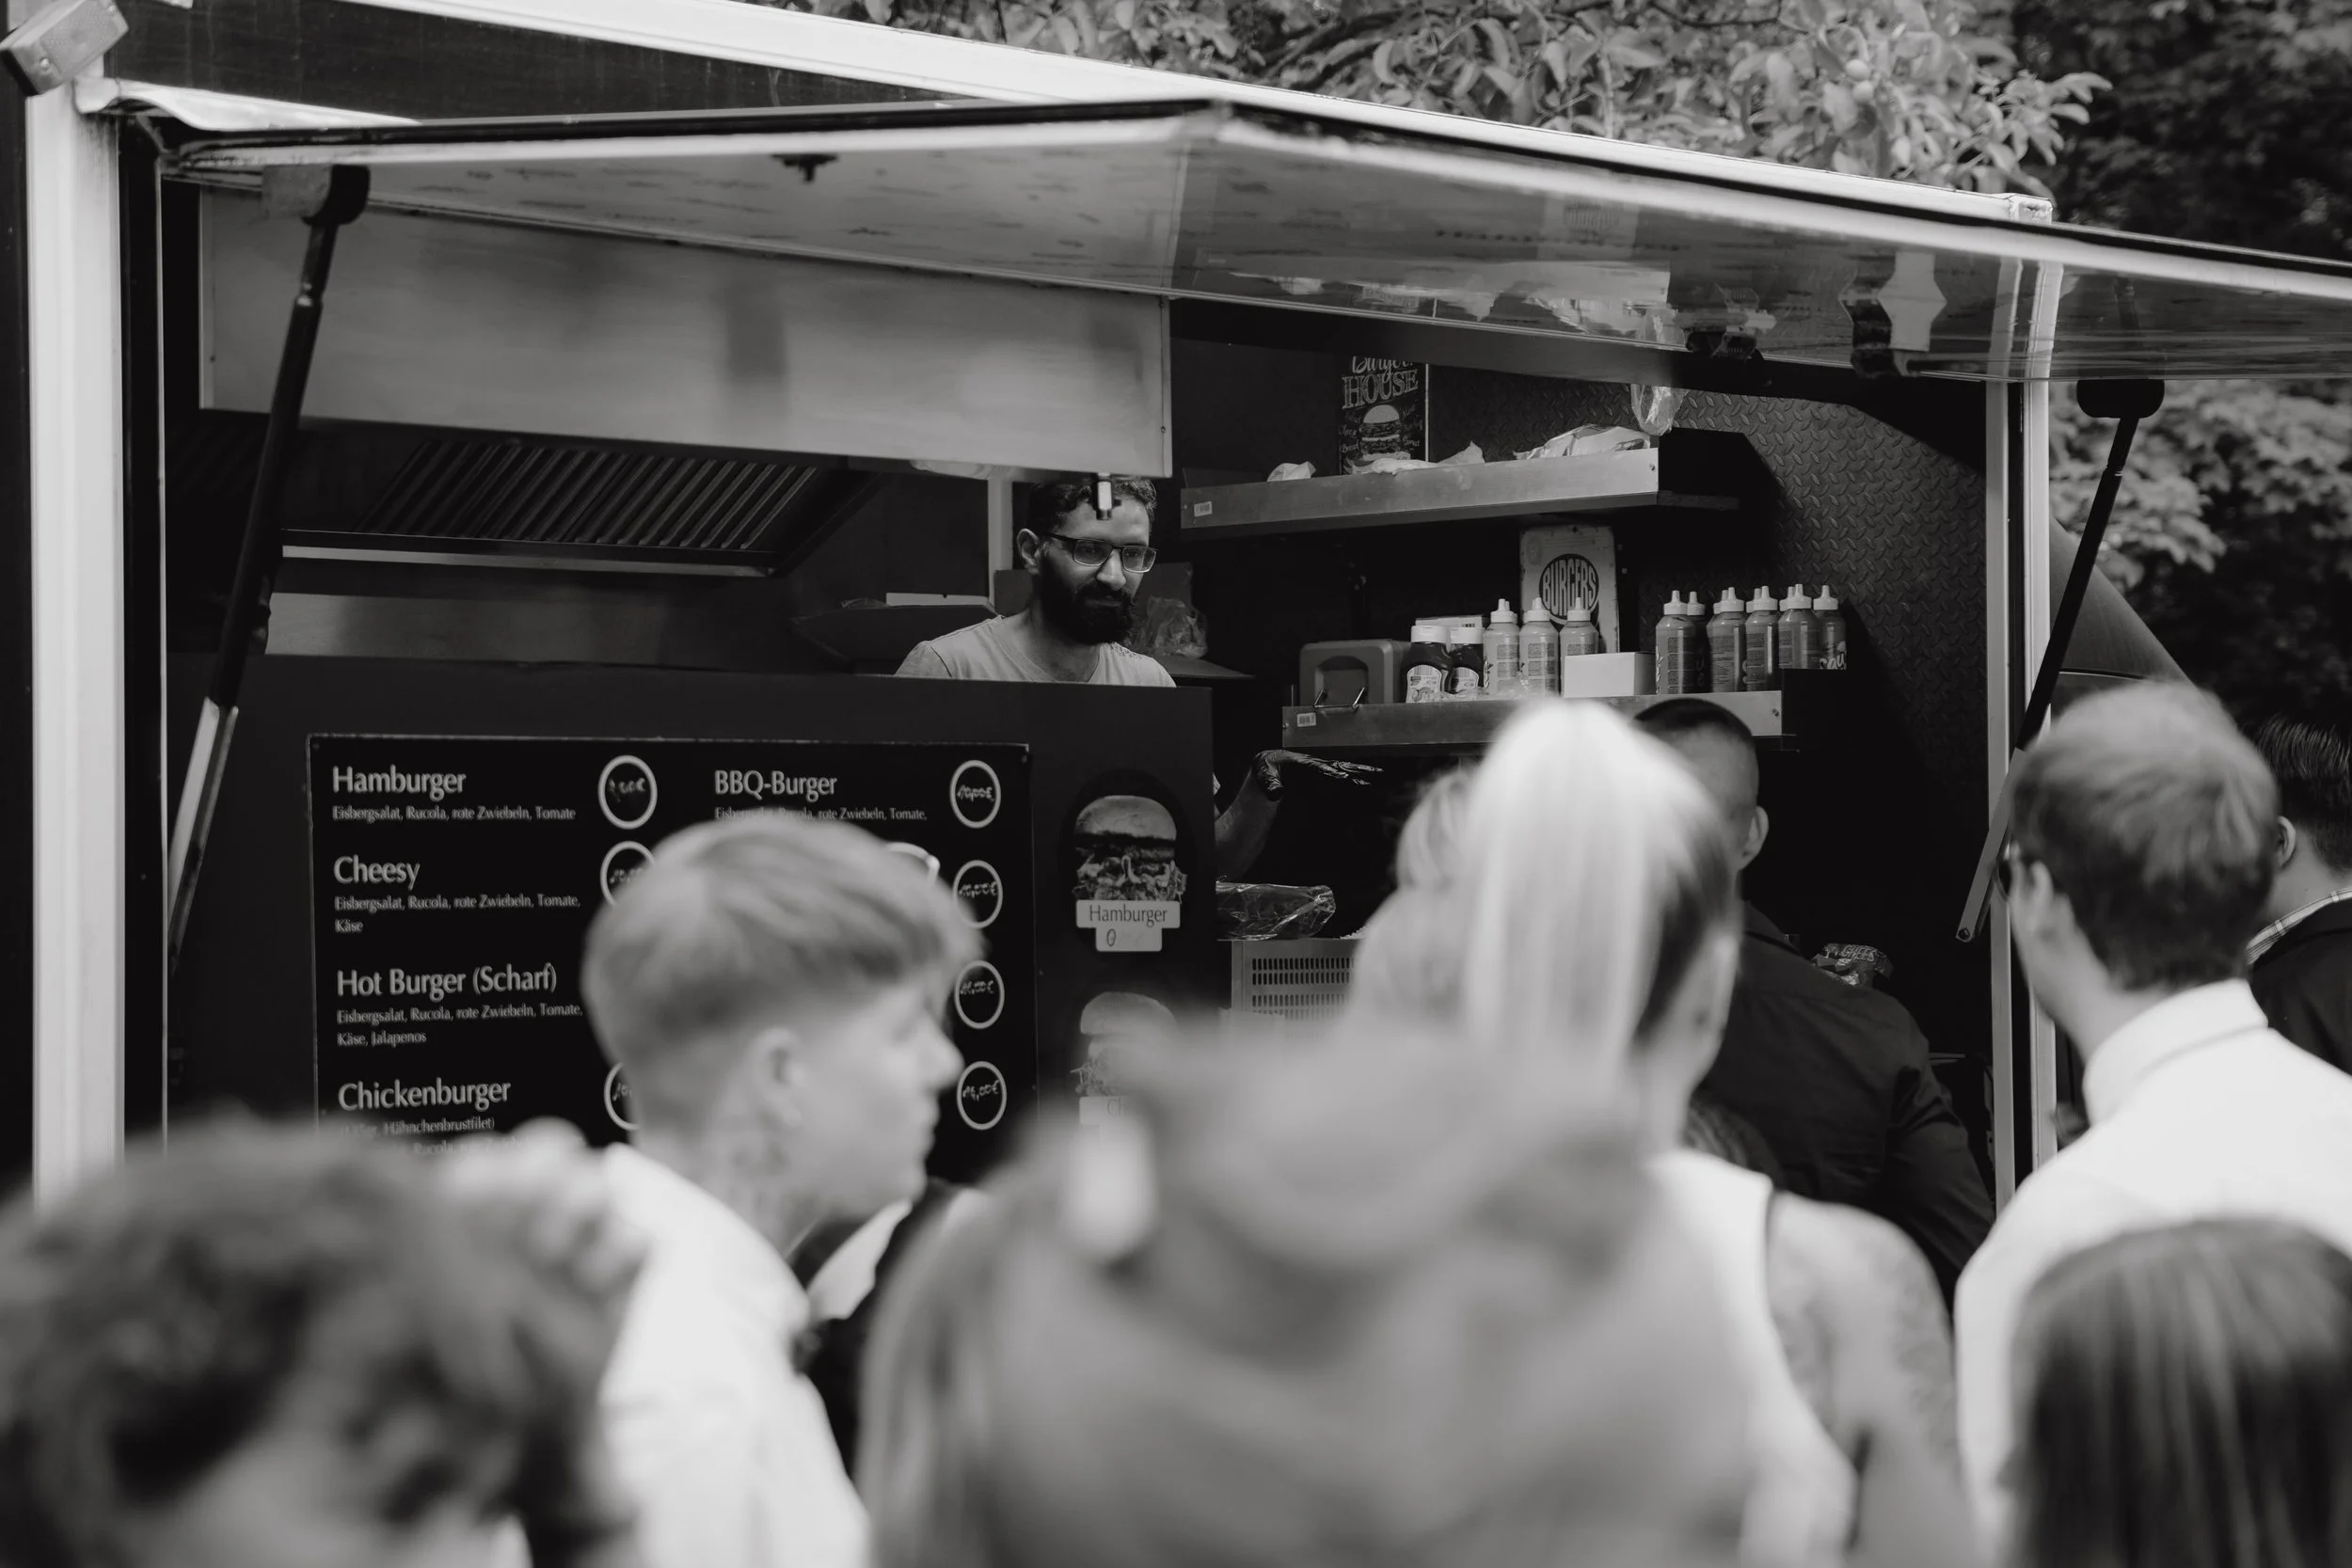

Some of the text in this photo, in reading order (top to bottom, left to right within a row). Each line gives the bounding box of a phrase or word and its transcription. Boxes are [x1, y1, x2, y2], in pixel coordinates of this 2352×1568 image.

[1342, 369, 1420, 410] HOUSE
[1542, 559, 1597, 617] BURGERS
[333, 765, 466, 800] Hamburger
[715, 770, 837, 802] BBQ-Burger
[333, 805, 576, 822] Eisbergsalat, Rucola, rote Zwiebeln, Tomate
[818, 808, 838, 820] rote
[840, 808, 886, 821] Zwiebeln,
[891, 808, 927, 819] Tomate,
[334, 855, 420, 890] Cheesy
[335, 894, 580, 912] Eisbergsalat, Rucola, rote Zwiebeln, Tomate,
[1089, 903, 1168, 927] Hamburger
[335, 920, 363, 932] Käse
[338, 963, 556, 1002] Hot Burger (Scharf)
[337, 1004, 582, 1025] Eisbergsalat, Rucola, rote Zwiebeln, Tomate,
[338, 1031, 426, 1047] Käse, Jalapenos
[339, 1077, 511, 1112] Chickenburger
[383, 1117, 496, 1136] Hähnchenbrustfilet)
